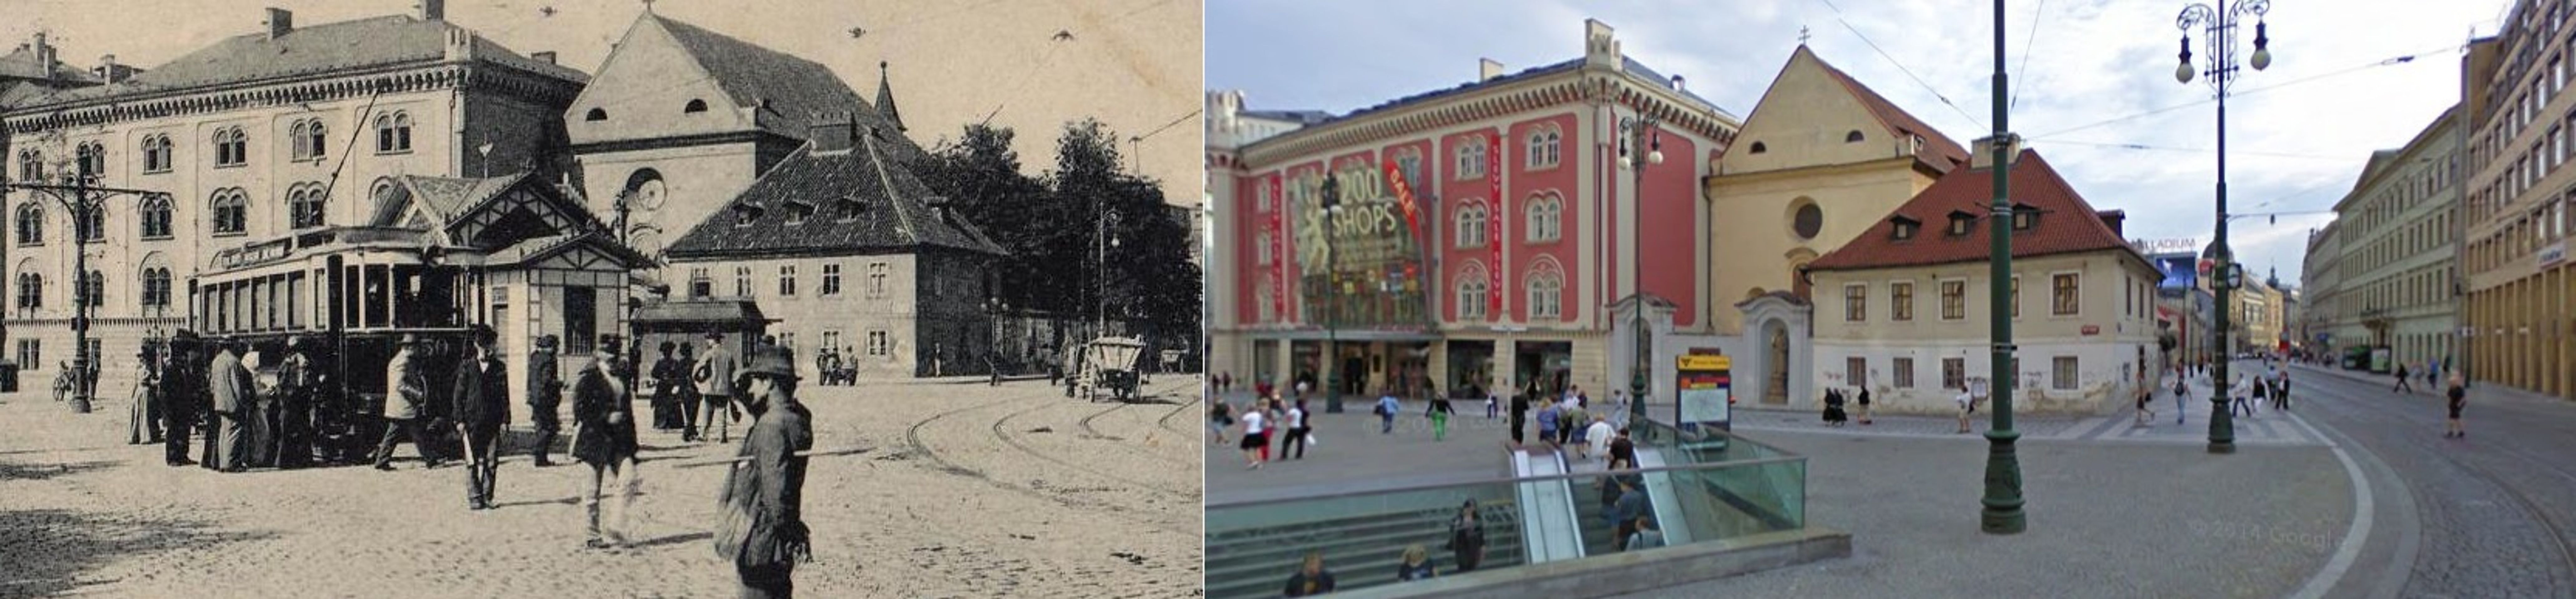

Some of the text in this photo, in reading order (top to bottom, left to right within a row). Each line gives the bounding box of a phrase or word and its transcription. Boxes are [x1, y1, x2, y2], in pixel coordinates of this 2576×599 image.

[1337, 168, 1381, 205] 200
[1390, 168, 1416, 217] SALE
[1332, 201, 1397, 236] SHOPS
